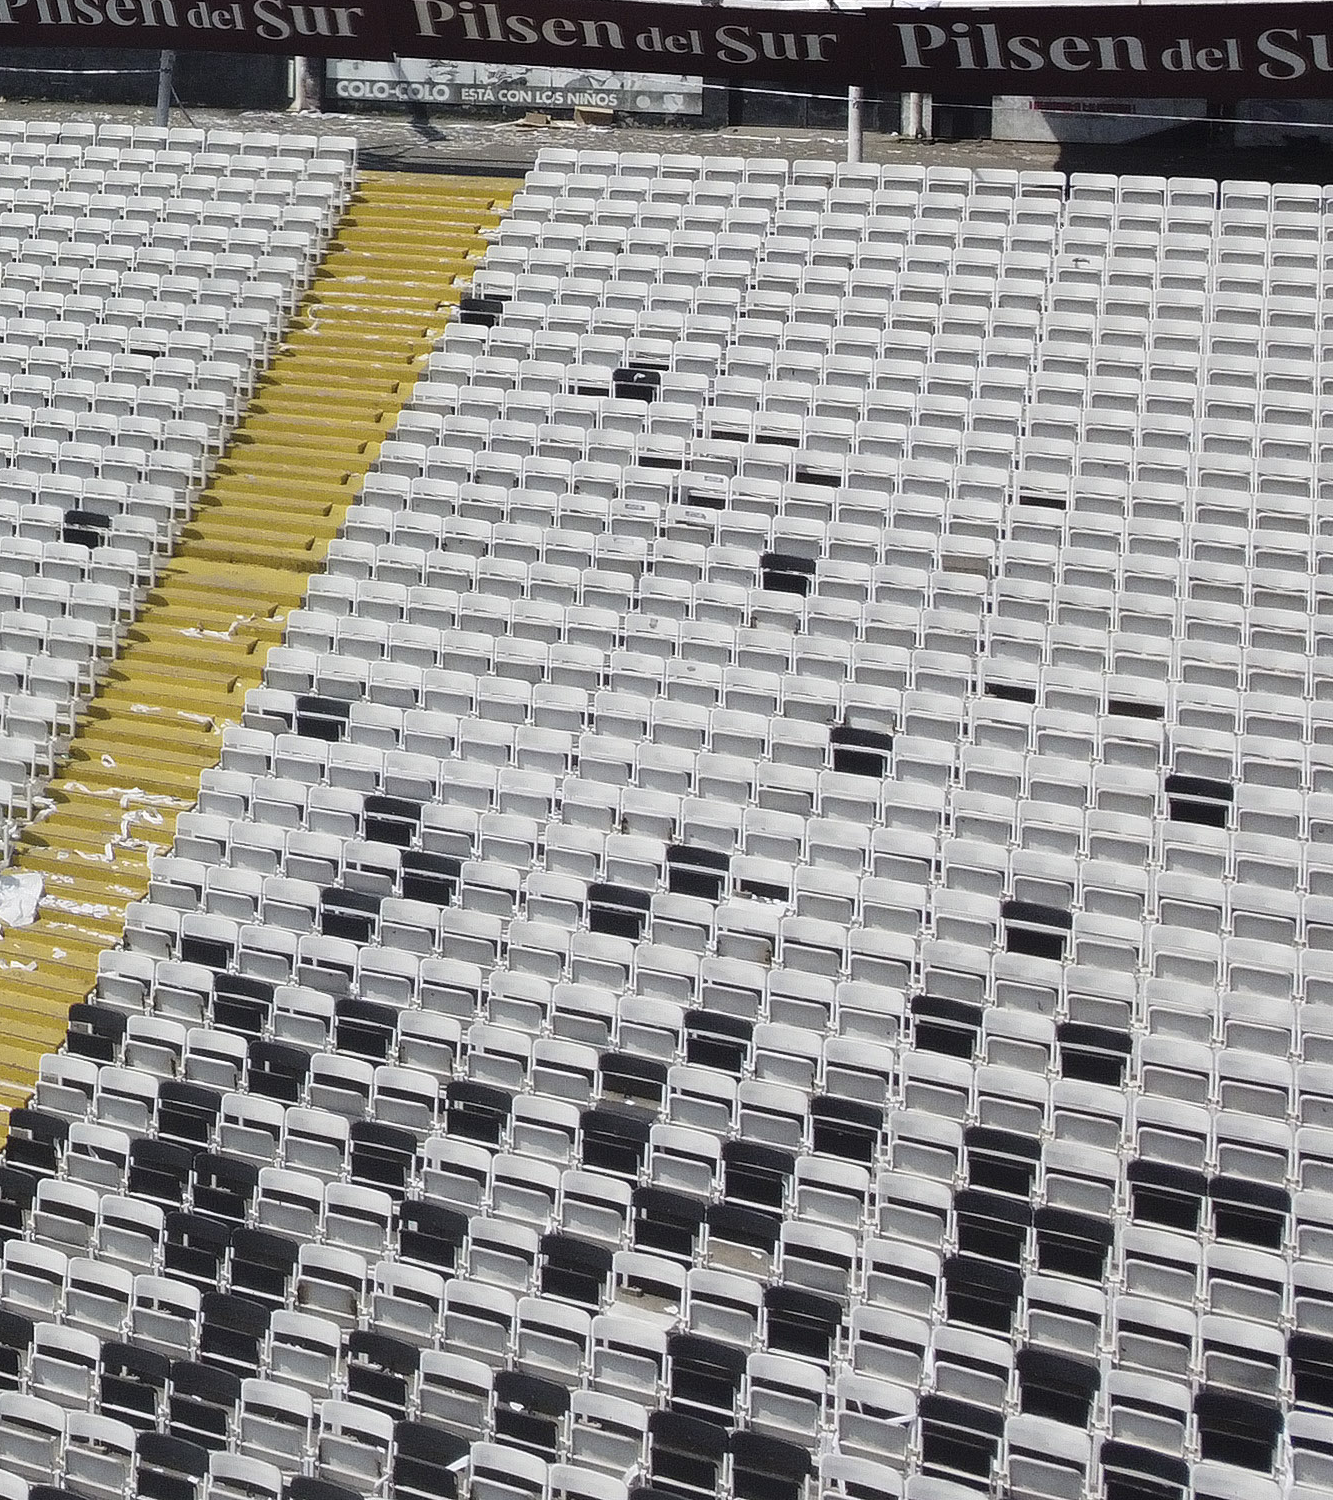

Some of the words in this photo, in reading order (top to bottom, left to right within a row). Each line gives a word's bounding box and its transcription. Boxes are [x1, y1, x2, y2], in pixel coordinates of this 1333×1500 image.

[187, 1, 246, 31] del
[635, 26, 705, 56] del
[715, 25, 839, 65] Sur
[893, 22, 1149, 71] Pilsen
[1161, 38, 1244, 71] del
[336, 80, 450, 101] COLO-COLO
[461, 86, 495, 101] ESTÁ
[498, 90, 532, 102] CON
[535, 91, 564, 104] LOS
[567, 90, 618, 106] NIÑOS
